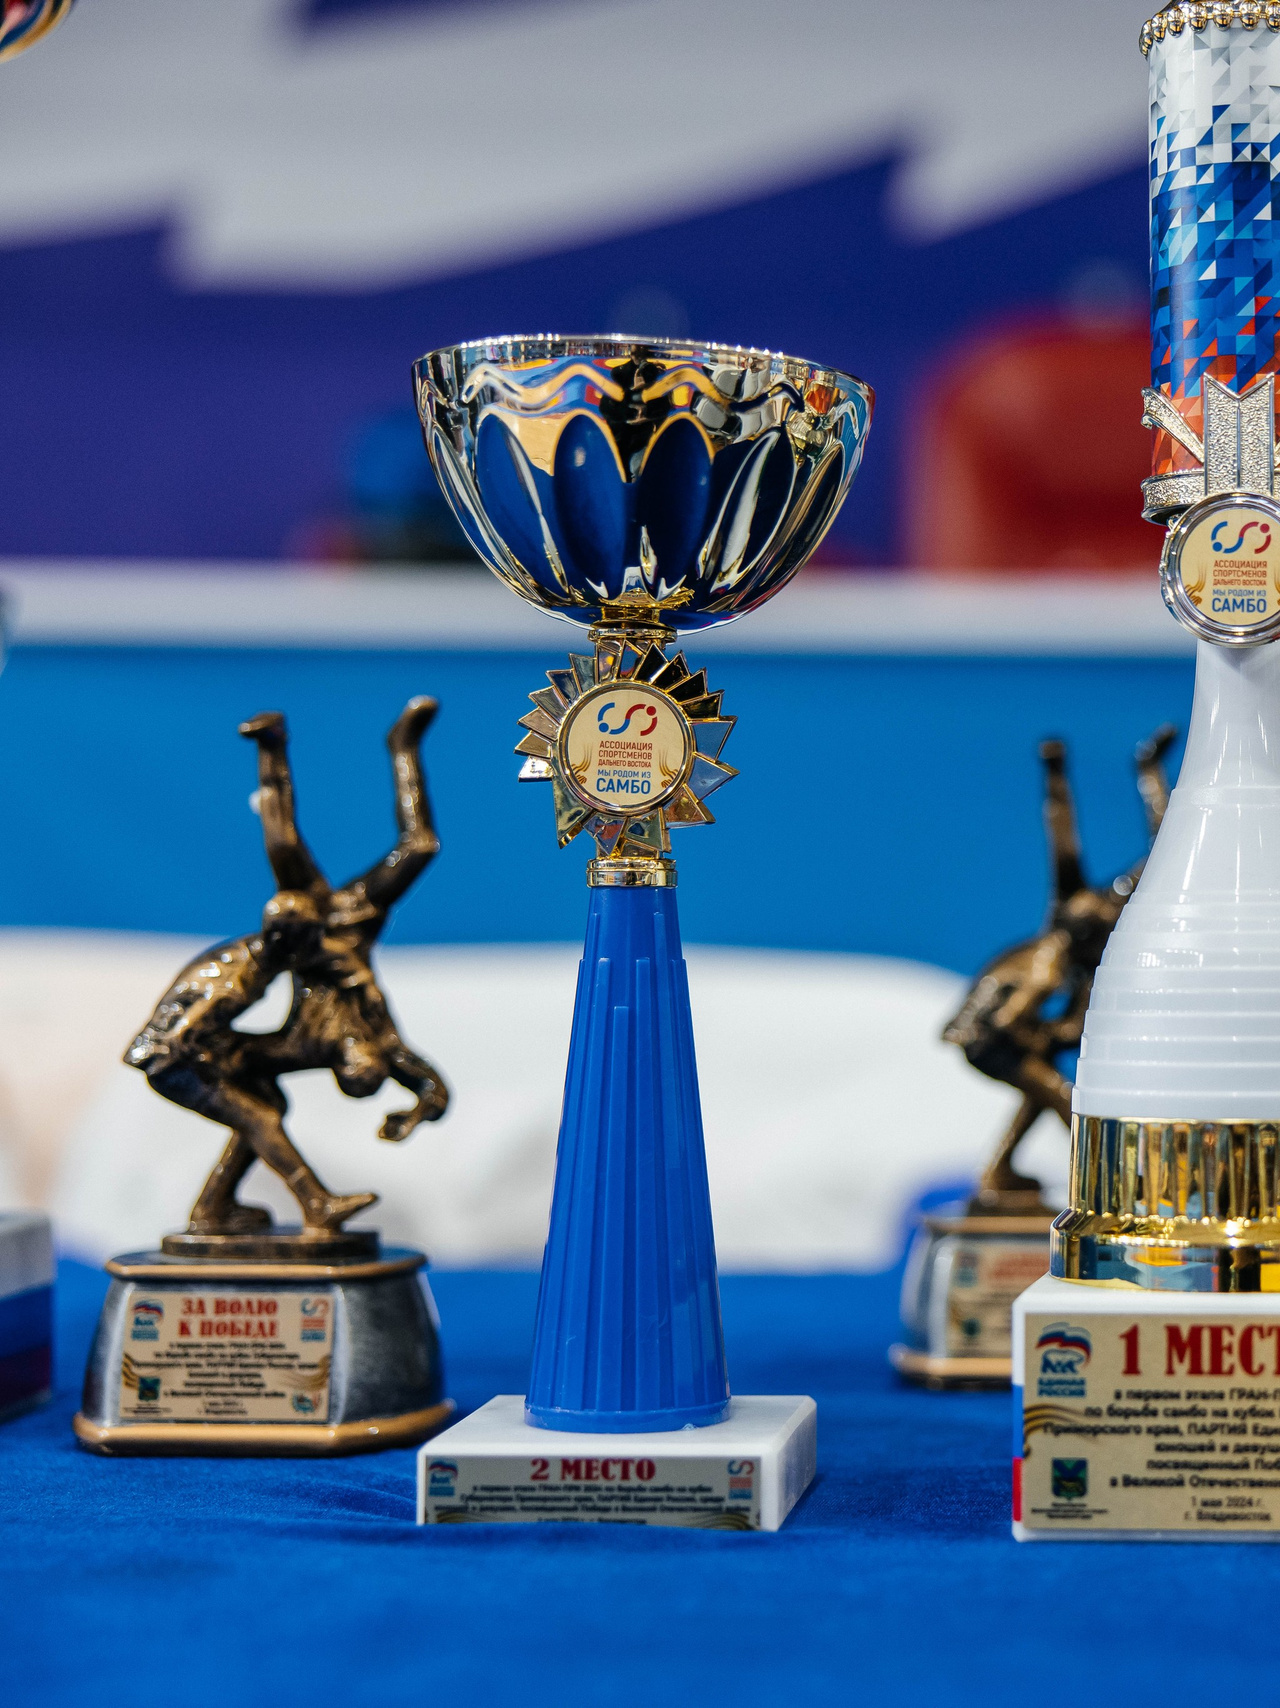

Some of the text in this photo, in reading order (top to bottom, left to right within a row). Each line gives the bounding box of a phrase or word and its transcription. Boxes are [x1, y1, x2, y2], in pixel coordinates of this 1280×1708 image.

[1213, 560, 1268, 570] АССОЦИАЦИЯ
[1212, 569, 1268, 579] СПОРТСМЕНОВ
[1212, 578, 1267, 587] ДАЛЬНЕГО ВОСТОКА
[1212, 589, 1267, 598] МЫ РОДОМ ИЗ
[1211, 597, 1267, 613] САМБО
[599, 740, 653, 751] АССОЦИАЦИЯ
[598, 750, 653, 760] СПОРТСМЕНОВ
[597, 758, 652, 768] ДАЛЬНЕГО ВОСТОКА
[597, 769, 652, 779] МЫ РОДОМ ИЗ
[596, 777, 651, 795] САМБО
[181, 1297, 278, 1316] ЗА ВОЛЮ
[178, 1320, 192, 1338] К
[1119, 1323, 1141, 1377] 1
[530, 1458, 657, 1482] 2 МЕСТО
